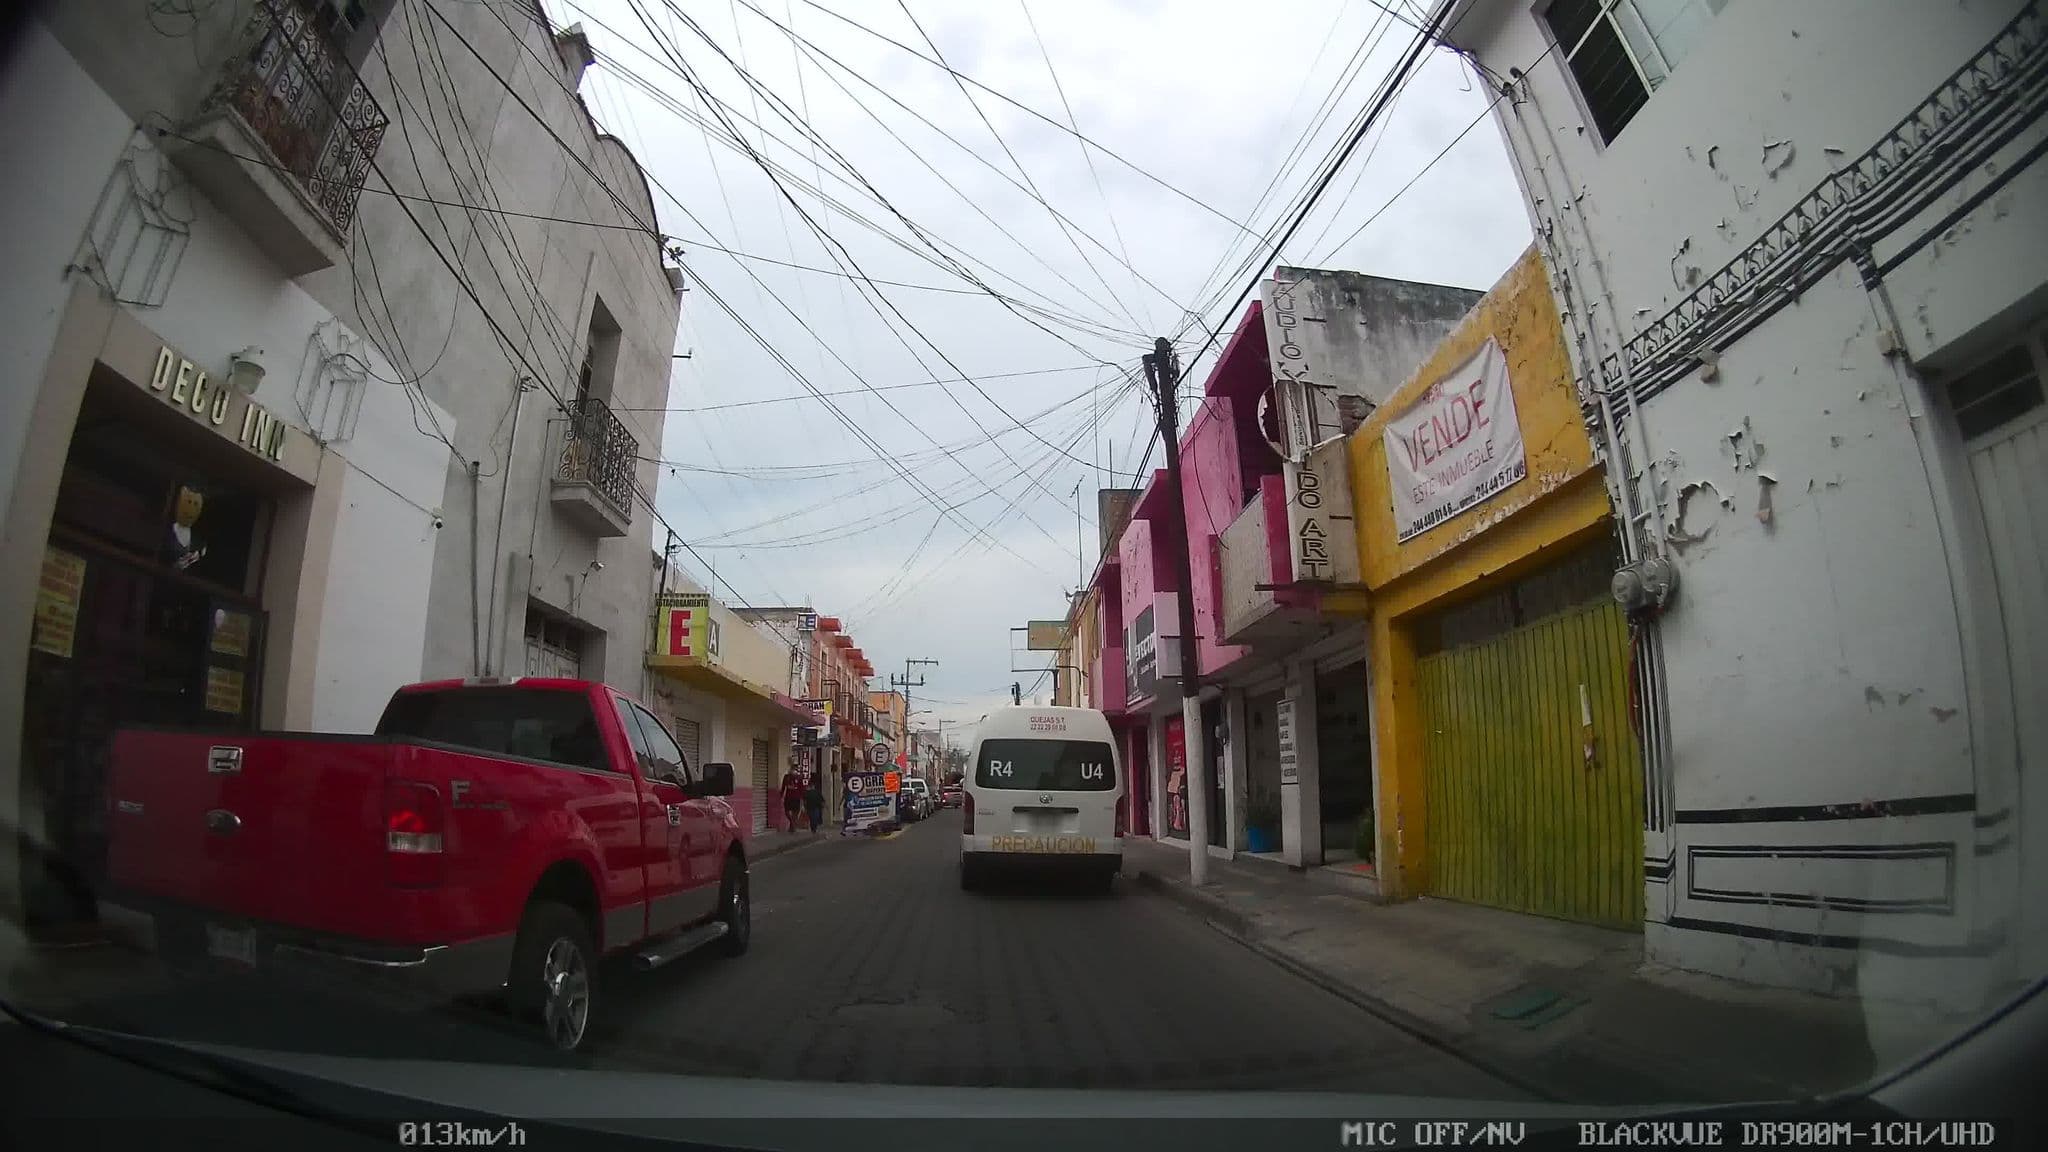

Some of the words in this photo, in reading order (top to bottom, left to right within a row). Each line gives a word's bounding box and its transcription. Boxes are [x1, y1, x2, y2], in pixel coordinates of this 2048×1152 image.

[151, 345, 231, 425] DECO
[240, 402, 286, 461] INN
[1403, 379, 1490, 473] VENDE
[1412, 477, 1437, 504] ESTE
[1438, 439, 1494, 488] INMUEBLE
[1300, 518, 1328, 577] ART
[670, 610, 691, 656] E
[876, 751, 884, 763] E
[990, 760, 1013, 777] R4
[1081, 763, 1104, 780] U4
[851, 779, 859, 790] E
[866, 776, 884, 787] GRA
[992, 835, 1096, 855] PRECAUCION
